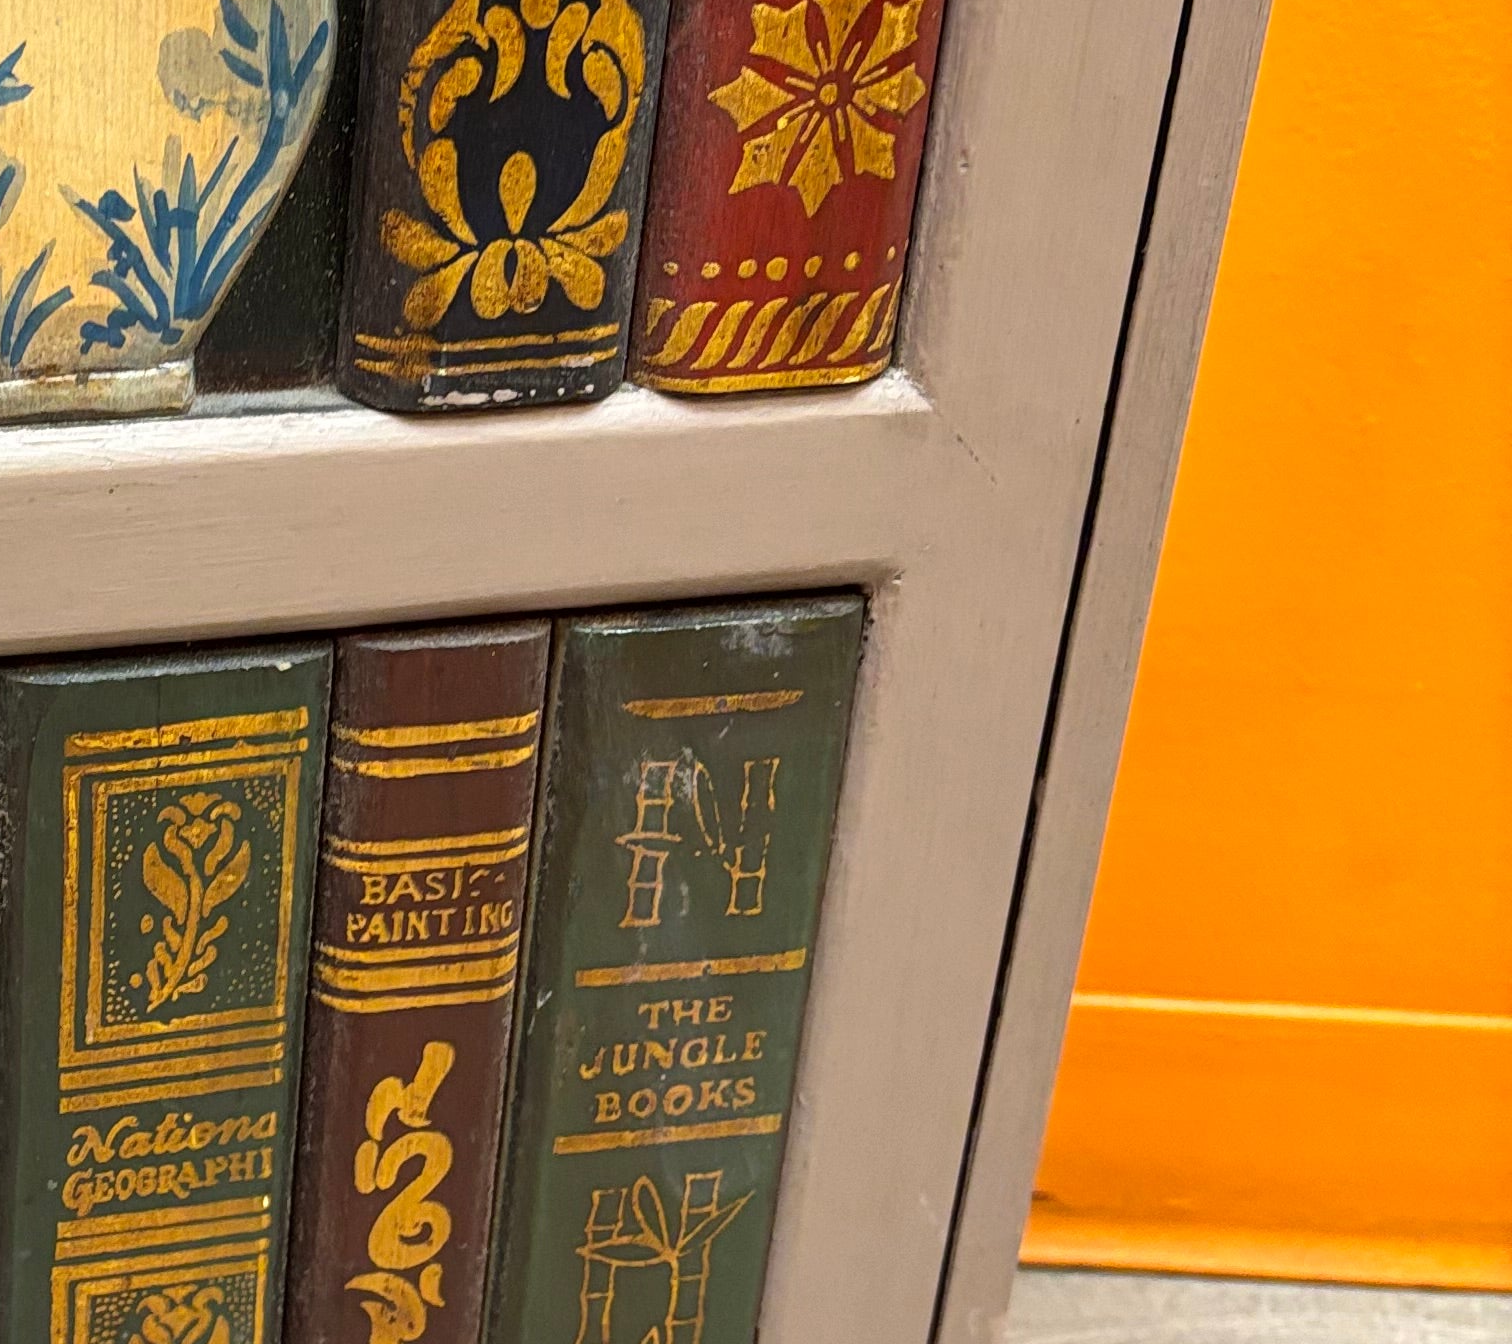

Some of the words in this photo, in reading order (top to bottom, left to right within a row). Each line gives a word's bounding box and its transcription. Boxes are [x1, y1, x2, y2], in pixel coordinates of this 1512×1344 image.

[346, 899, 513, 943] PAINTING
[638, 995, 733, 1030] THE
[578, 1030, 767, 1080] JUNGLE
[594, 1076, 756, 1124] BOOKS
